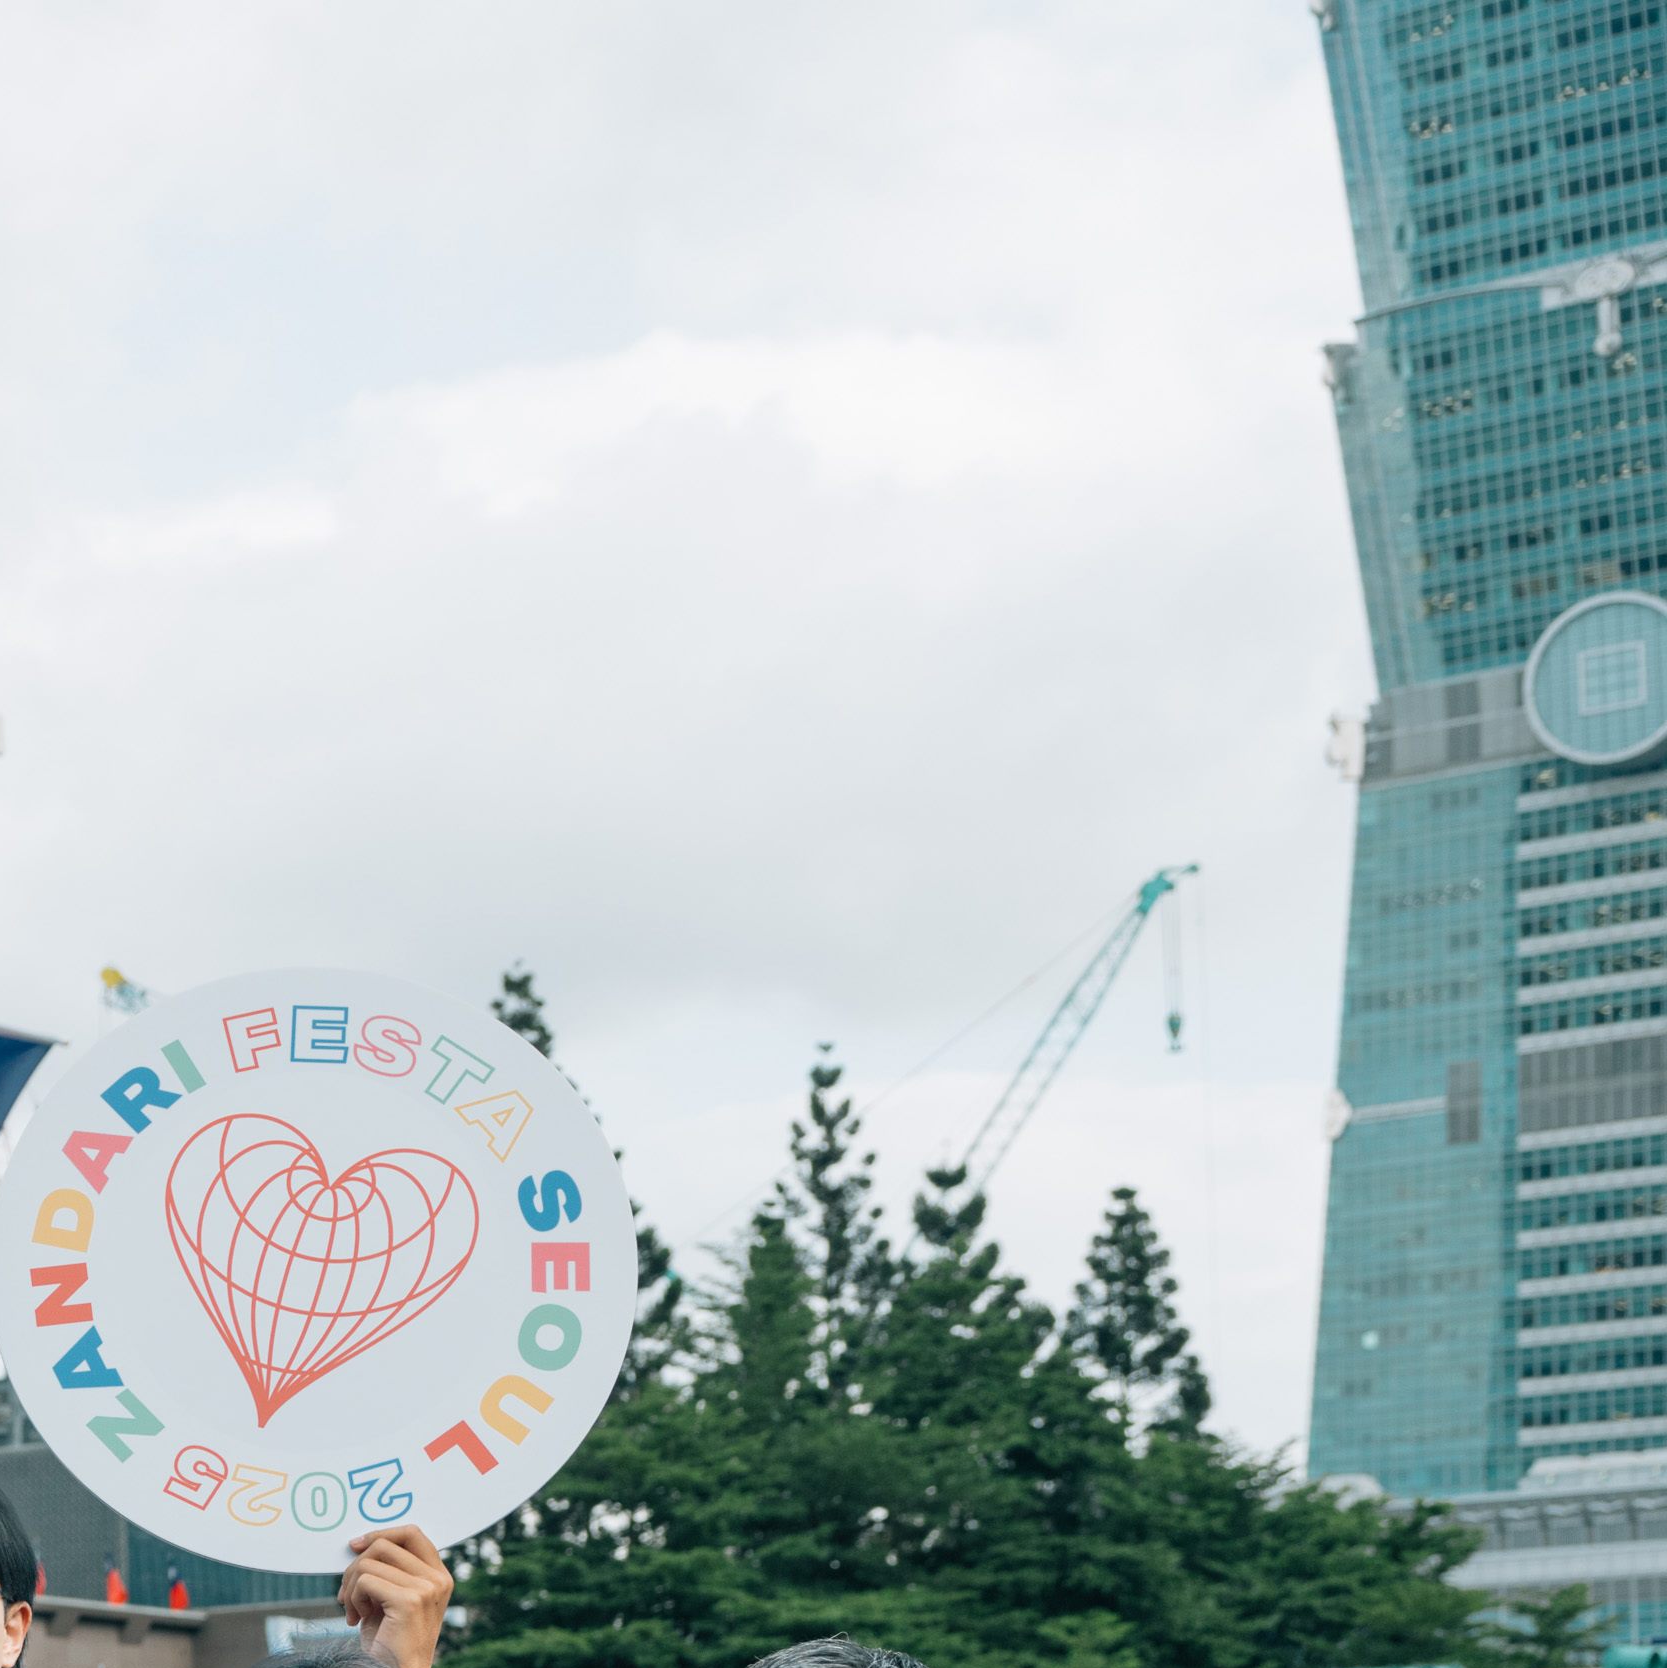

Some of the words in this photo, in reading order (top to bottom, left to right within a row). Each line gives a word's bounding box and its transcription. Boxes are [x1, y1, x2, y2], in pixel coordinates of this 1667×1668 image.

[223, 1005, 534, 1163] FESTA
[30, 1039, 207, 1463] ZANDARI
[423, 1169, 590, 1476] SEOUL
[164, 1444, 413, 1532] 2025
